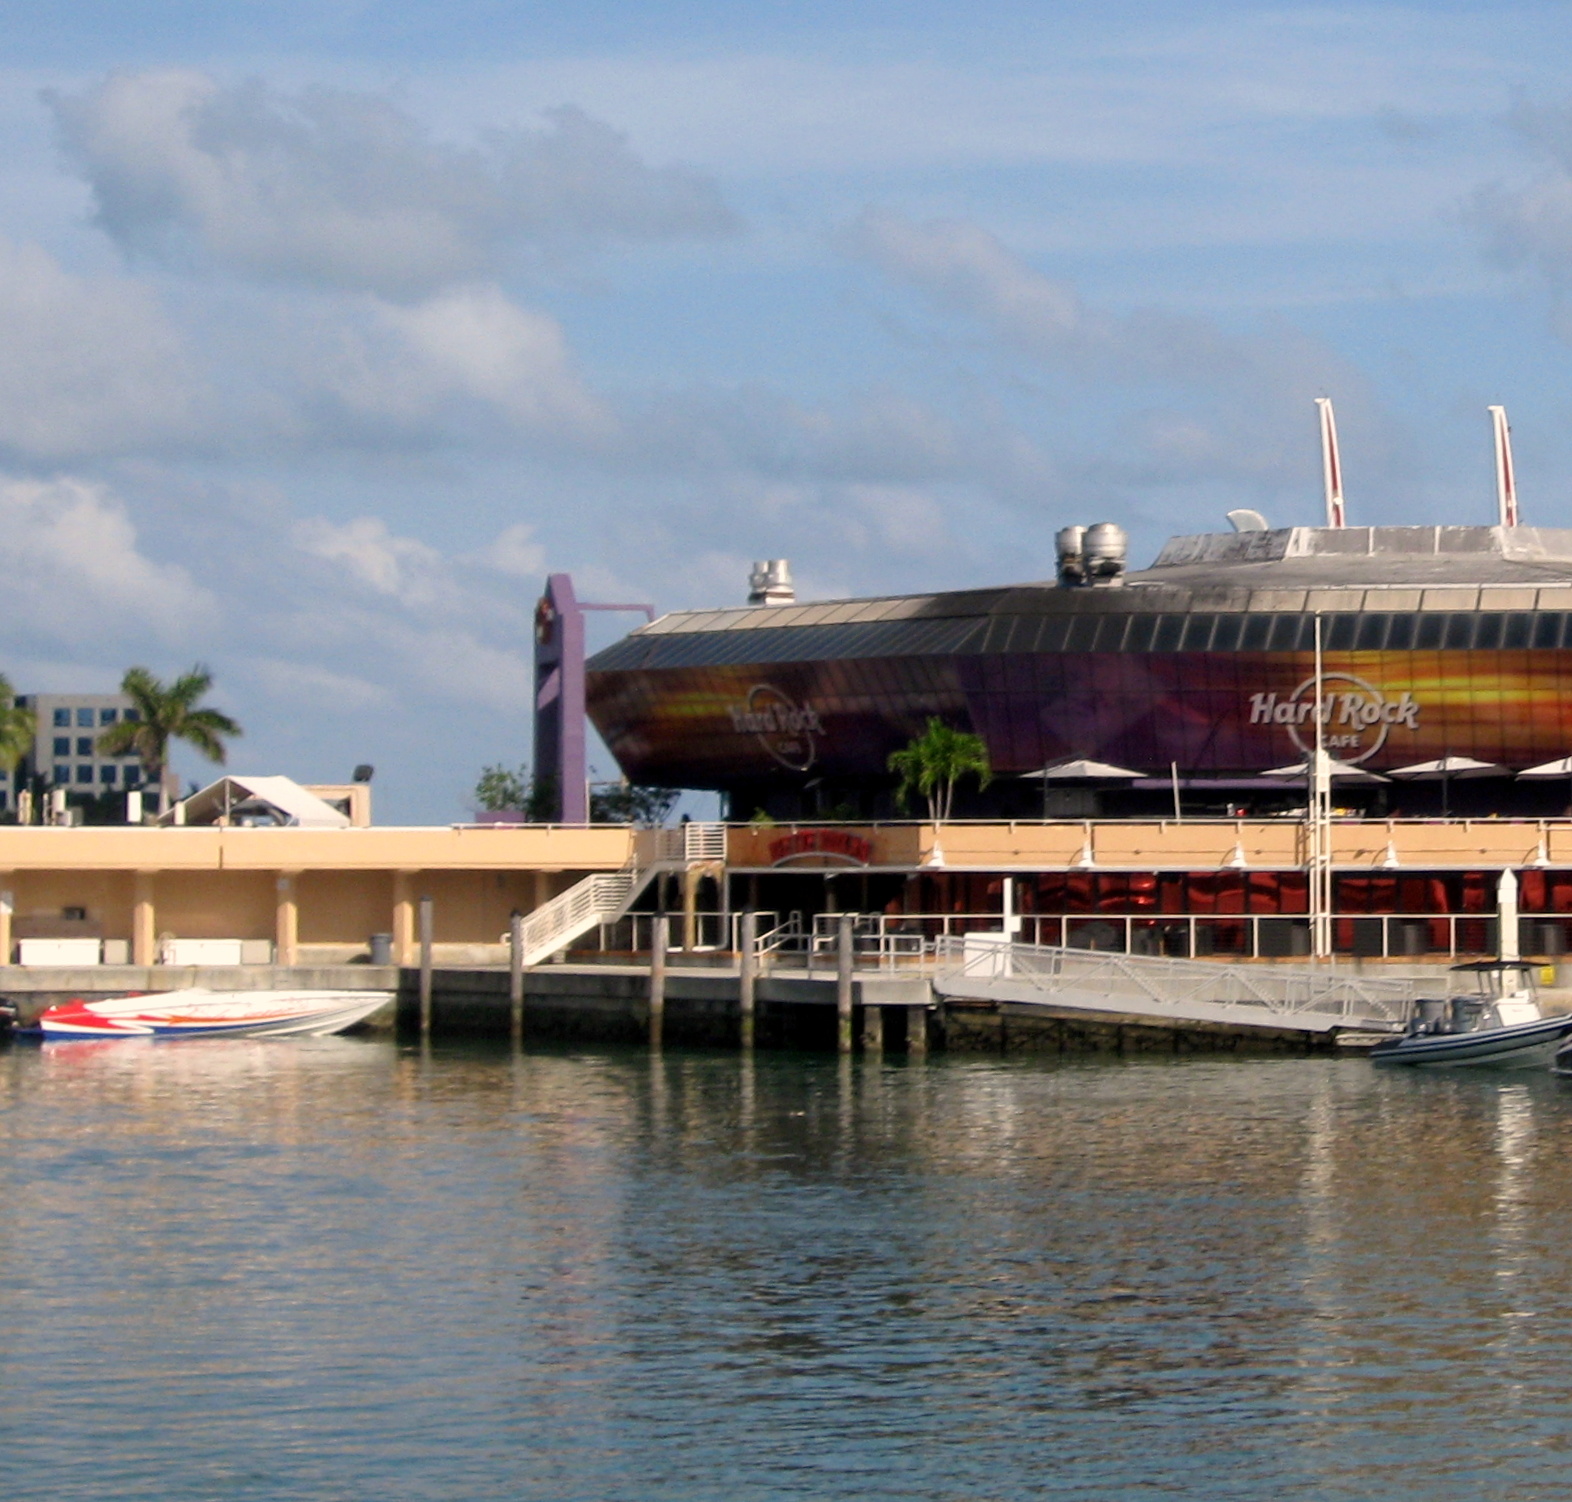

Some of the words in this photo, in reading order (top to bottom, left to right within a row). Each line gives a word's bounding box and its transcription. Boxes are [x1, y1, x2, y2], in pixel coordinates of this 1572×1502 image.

[724, 702, 778, 733] Hard
[771, 701, 827, 737] Rock
[1249, 692, 1335, 724] Hard
[1338, 692, 1420, 731] Rock
[1321, 734, 1361, 748] CAFE
